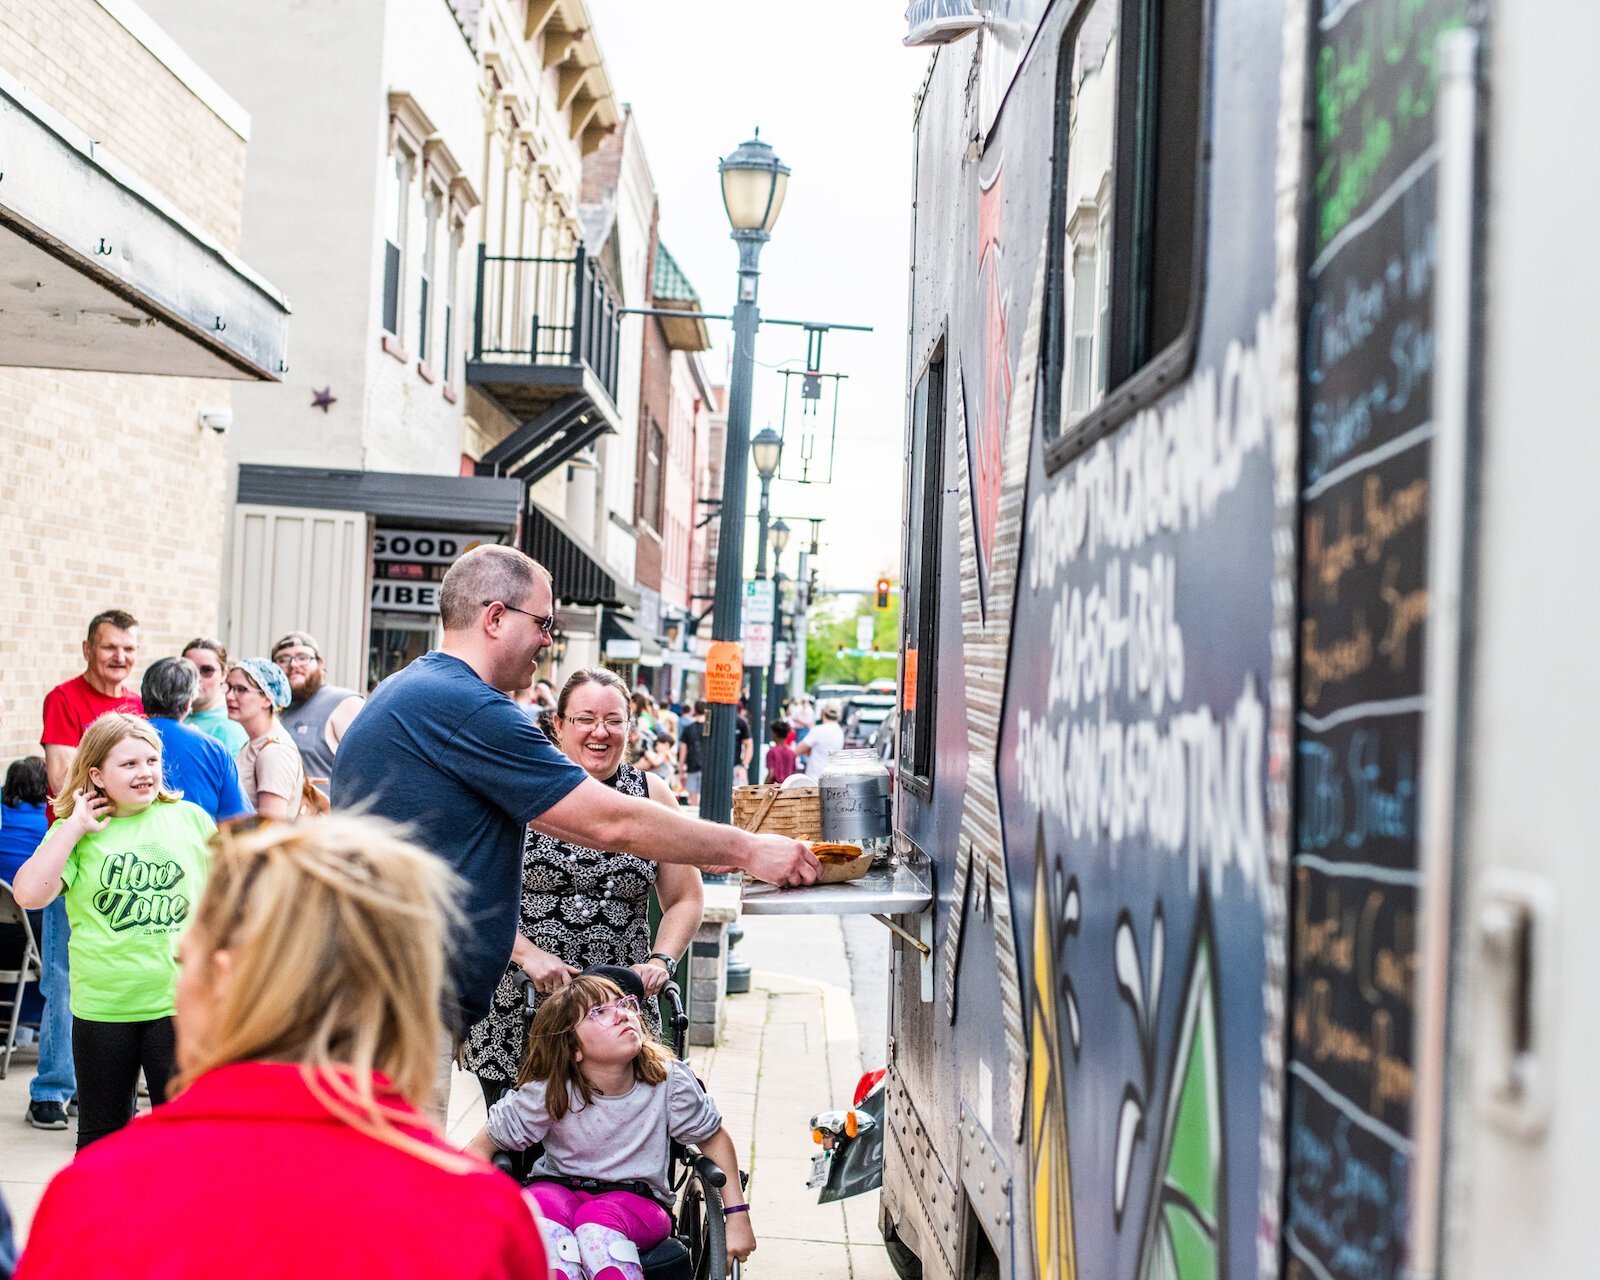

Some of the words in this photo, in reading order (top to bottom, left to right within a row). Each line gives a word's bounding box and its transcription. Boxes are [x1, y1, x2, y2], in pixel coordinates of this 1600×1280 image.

[374, 535, 457, 557] GOOD
[707, 672, 740, 680] PARKING
[715, 663, 731, 672] NO
[826, 786, 848, 800] Beer
[100, 852, 184, 892] Glow
[93, 889, 190, 932] Zone
